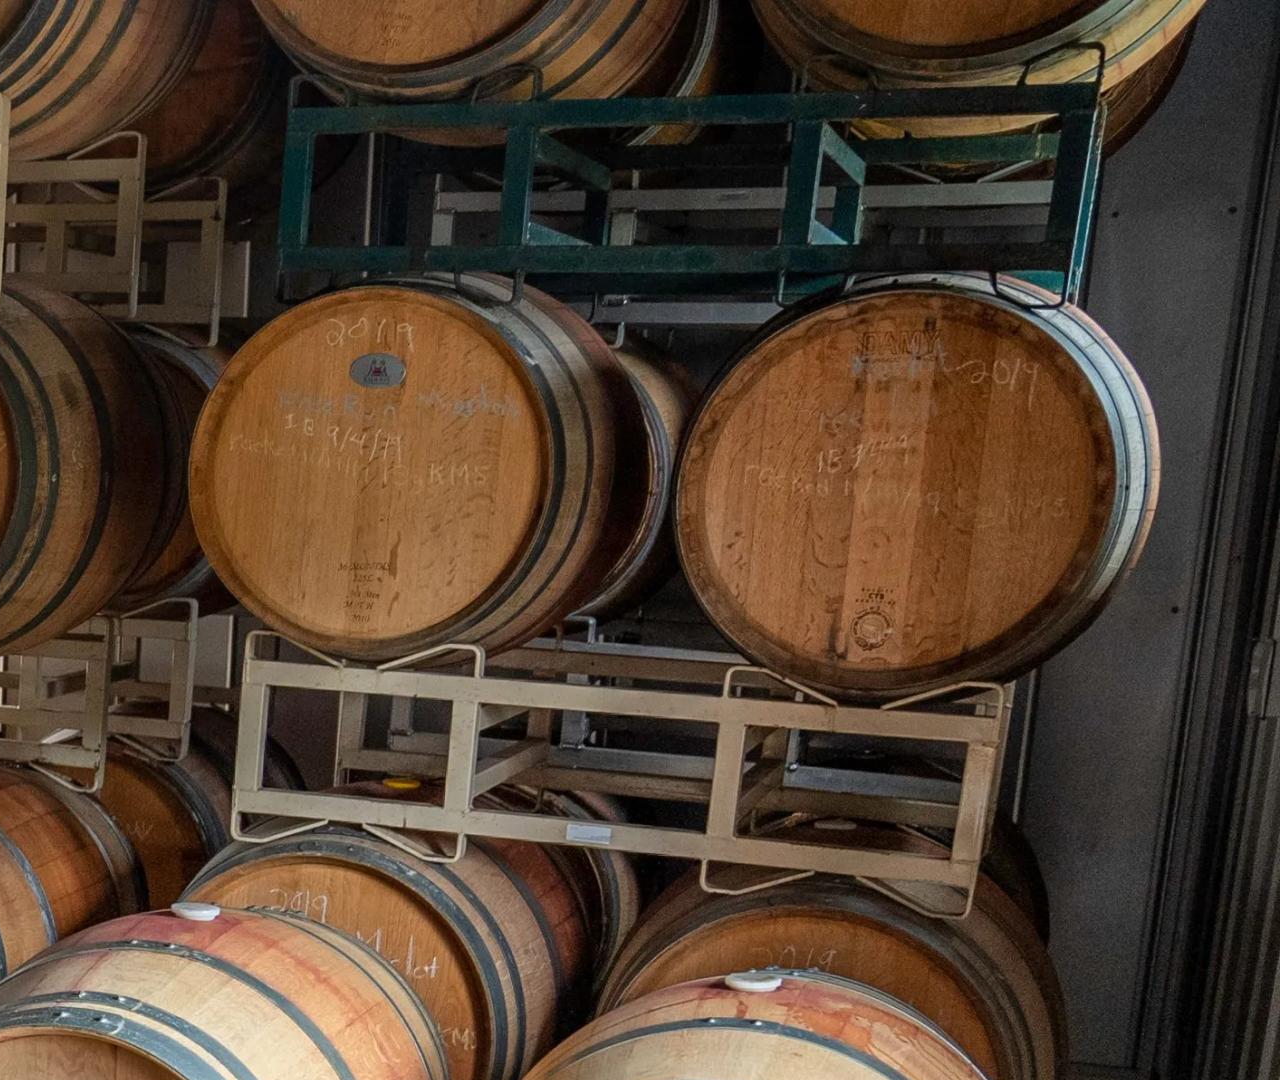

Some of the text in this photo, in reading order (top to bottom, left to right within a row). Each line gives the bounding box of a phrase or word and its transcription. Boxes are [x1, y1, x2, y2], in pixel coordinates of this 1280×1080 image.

[326, 316, 414, 353] 2019
[862, 329, 941, 356] DAMY
[956, 357, 1041, 412] 2019
[268, 887, 329, 924] 2019
